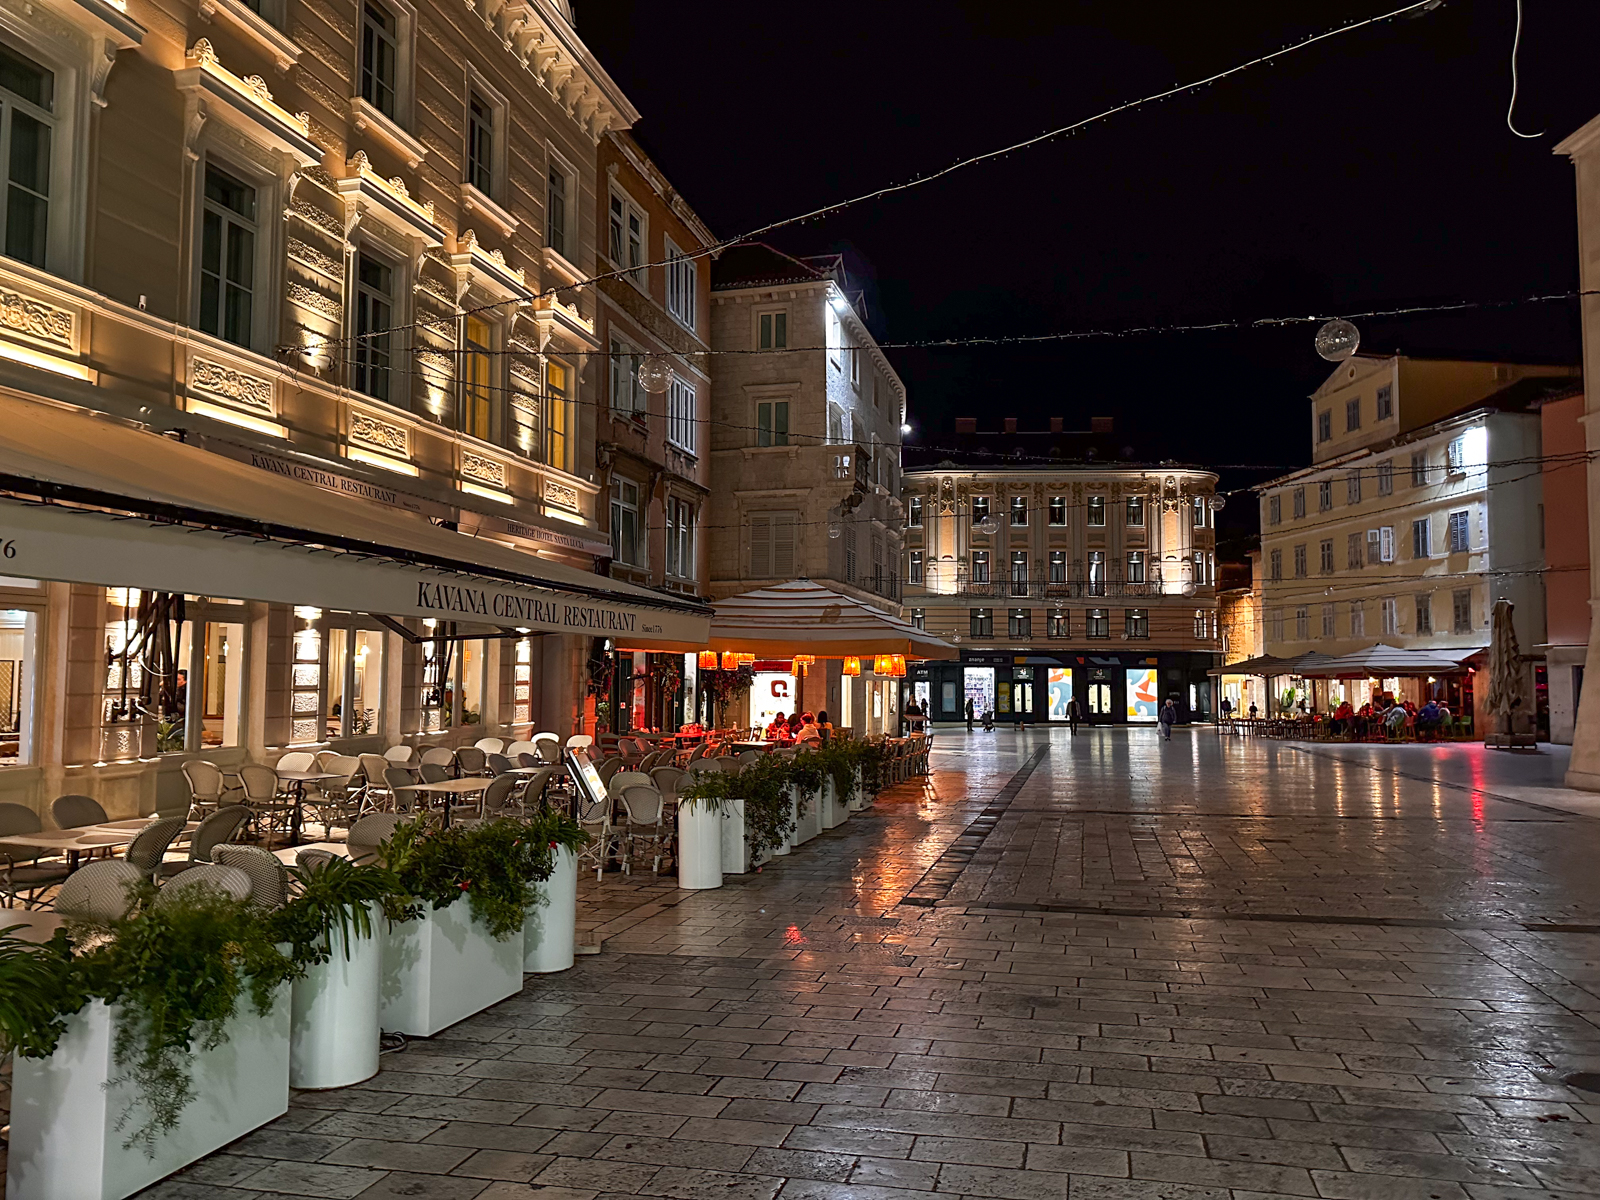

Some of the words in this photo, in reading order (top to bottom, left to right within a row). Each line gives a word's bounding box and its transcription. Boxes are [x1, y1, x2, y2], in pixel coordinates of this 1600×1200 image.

[251, 454, 291, 476] KAVANA
[293, 467, 338, 488] CENTRAL
[340, 479, 397, 503] RESTAURANT
[507, 523, 536, 537] HERITAGE
[536, 530, 553, 542] HOTEL
[554, 534, 570, 546] SANTA
[570, 538, 584, 549] LUCIA
[416, 581, 489, 615] KAVANA
[493, 592, 560, 624] CENTRAL
[563, 605, 637, 632] RESTAURANT
